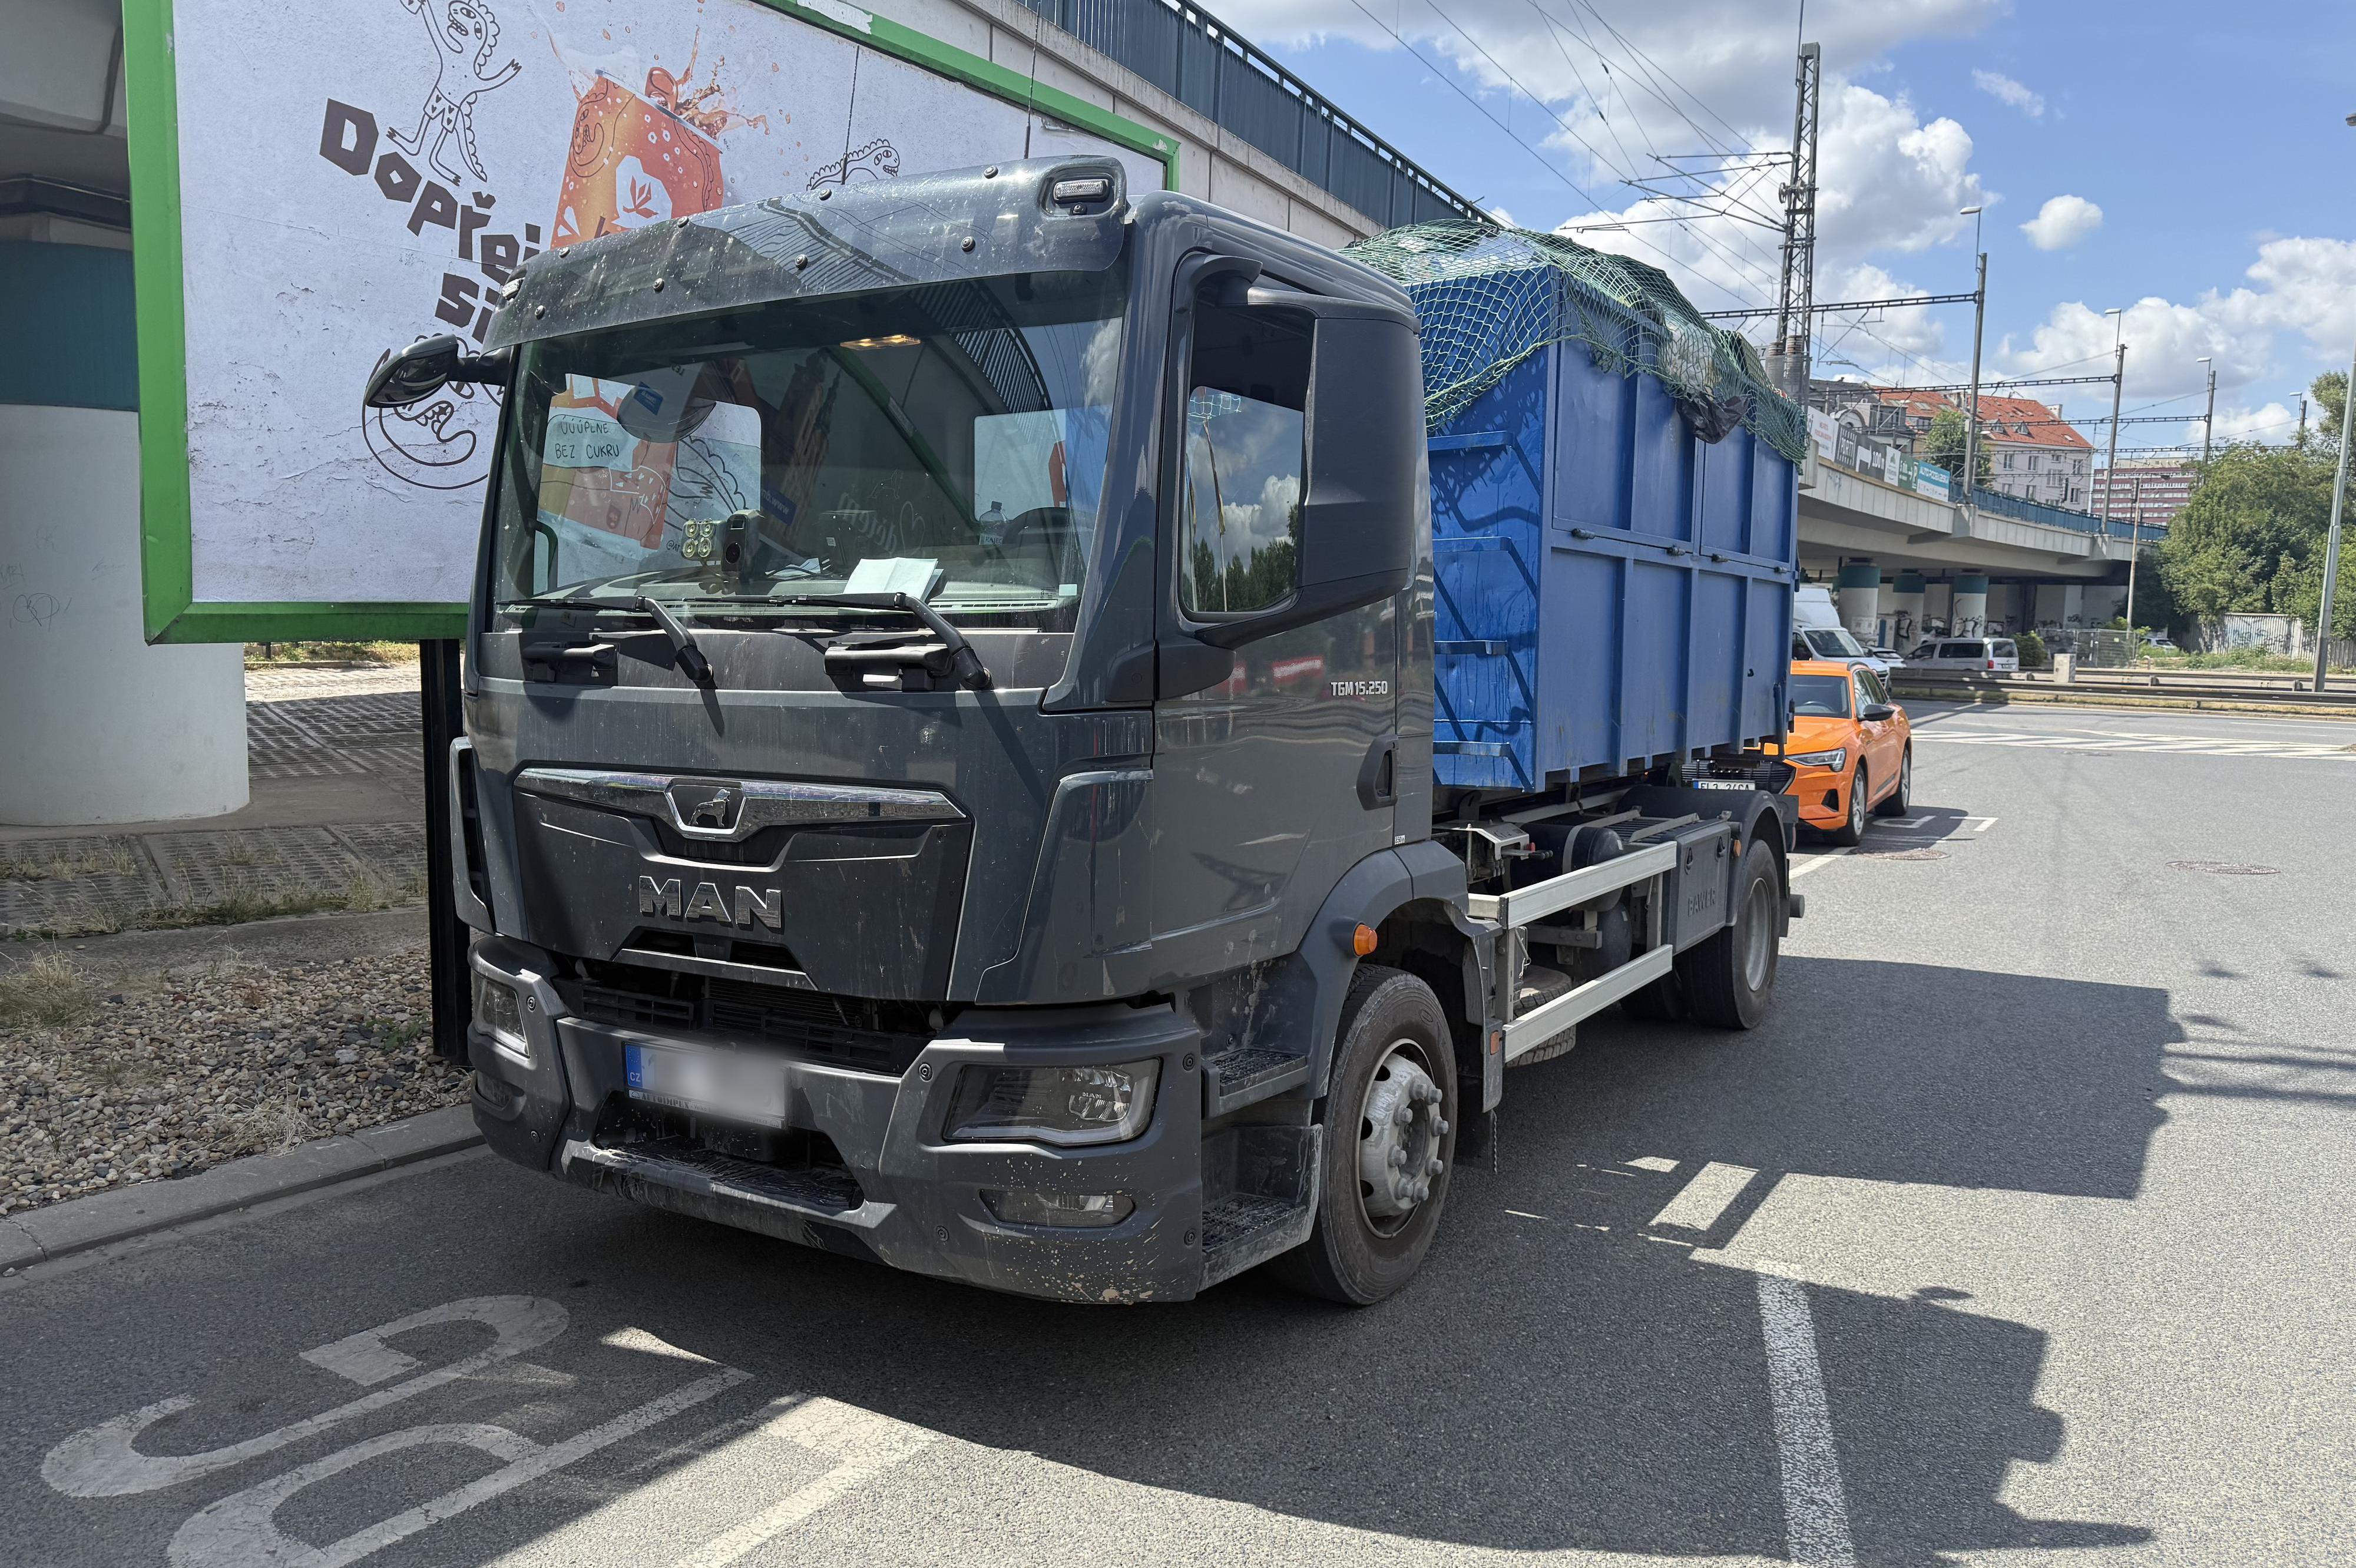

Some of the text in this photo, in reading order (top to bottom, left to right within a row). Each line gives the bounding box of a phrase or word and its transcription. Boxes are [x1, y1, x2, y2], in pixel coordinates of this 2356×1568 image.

[435, 273, 500, 344] si
[560, 415, 609, 434] ÚÚÚPLNE
[555, 443, 620, 459] BEZ CUKRU
[1331, 680, 1388, 696] TGM 15.250
[639, 875, 782, 929] MAN
[630, 1071, 641, 1083] CZ
